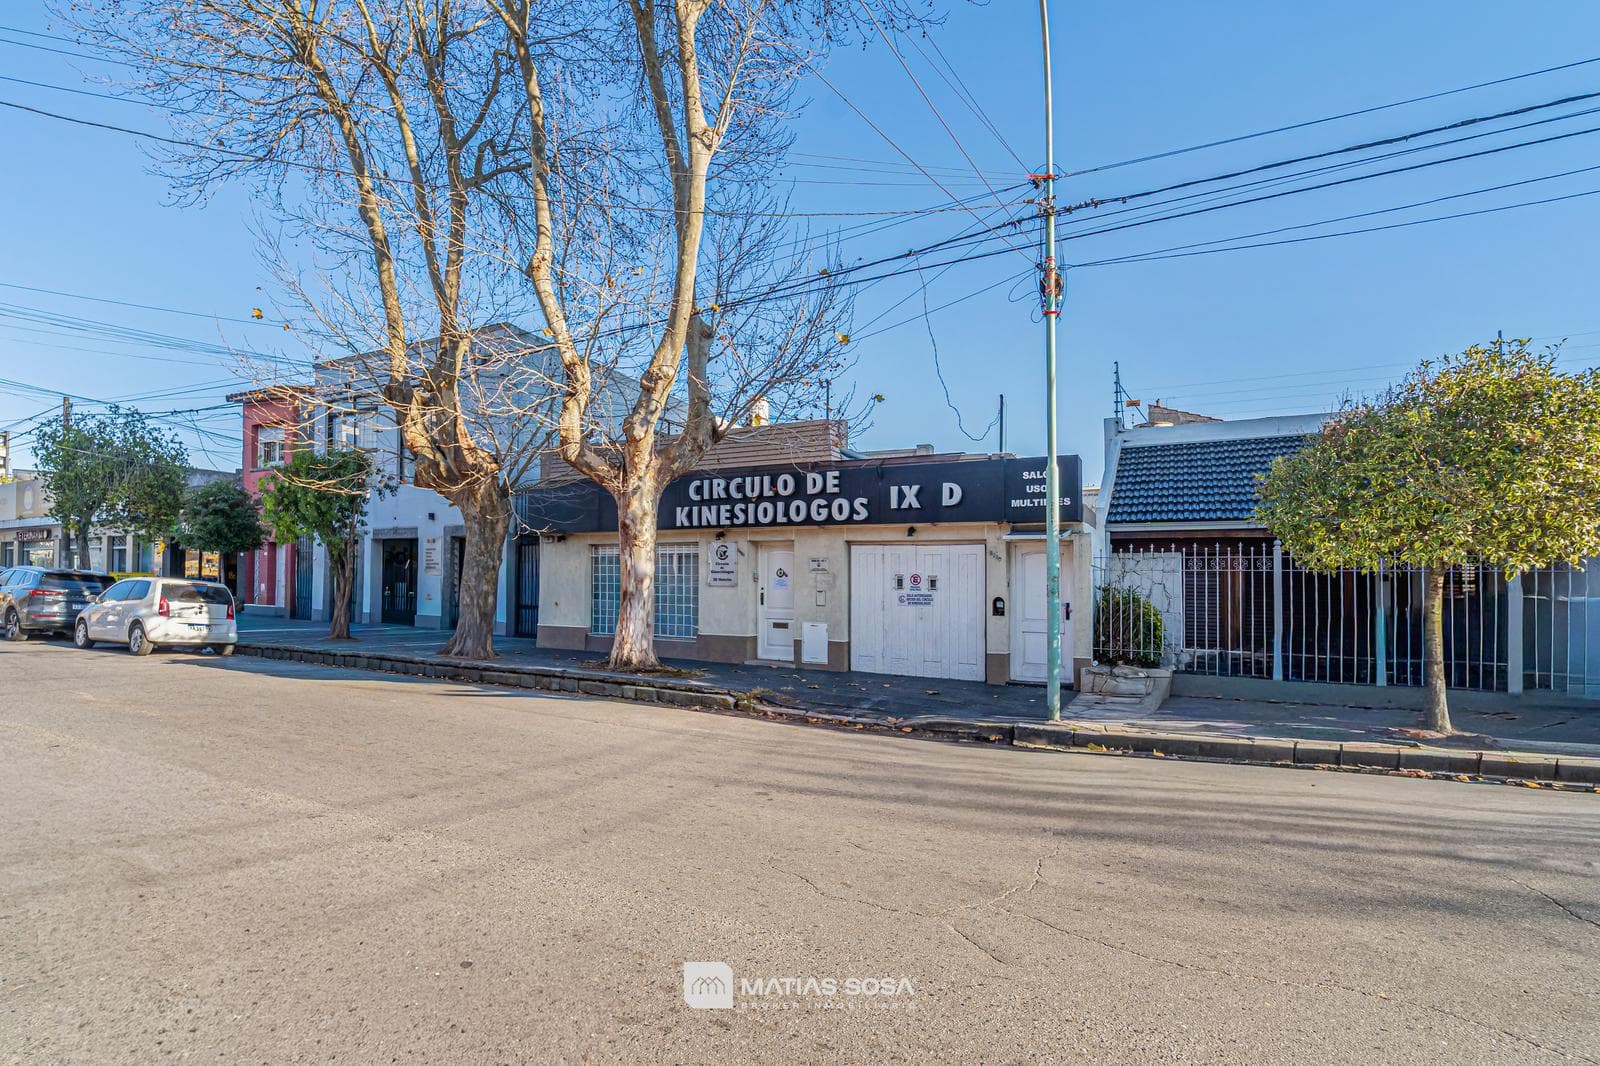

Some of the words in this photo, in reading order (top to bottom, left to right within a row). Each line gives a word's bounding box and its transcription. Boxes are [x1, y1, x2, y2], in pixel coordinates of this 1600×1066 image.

[688, 474, 796, 501] CIRCULO
[806, 470, 840, 495] DE
[889, 485, 921, 509] IX
[941, 482, 963, 507] D
[675, 497, 869, 527] KINESIOLOGOS
[1011, 497, 1071, 508] MULTIES
